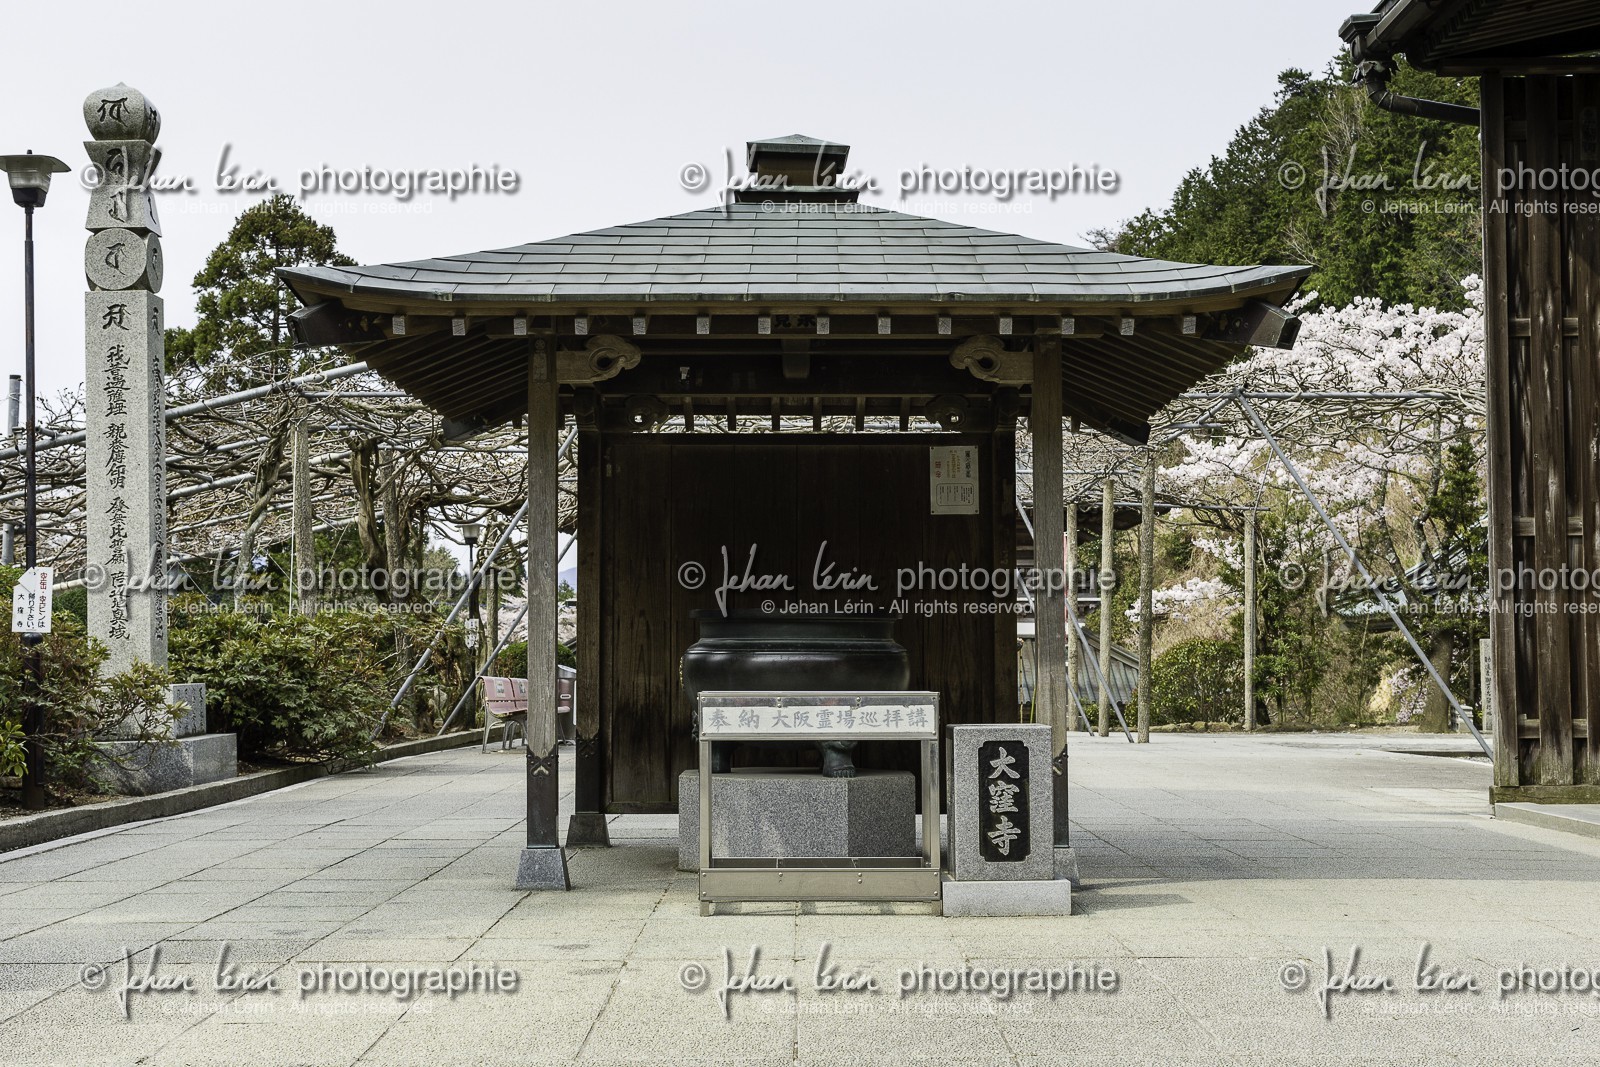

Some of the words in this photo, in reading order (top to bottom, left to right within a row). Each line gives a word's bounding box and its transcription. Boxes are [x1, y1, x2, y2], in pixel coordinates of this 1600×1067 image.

[708, 708, 760, 731] 奉納
[770, 708, 930, 730] 大阪霊場巡拝講
[987, 746, 1021, 856] 大窪寺
